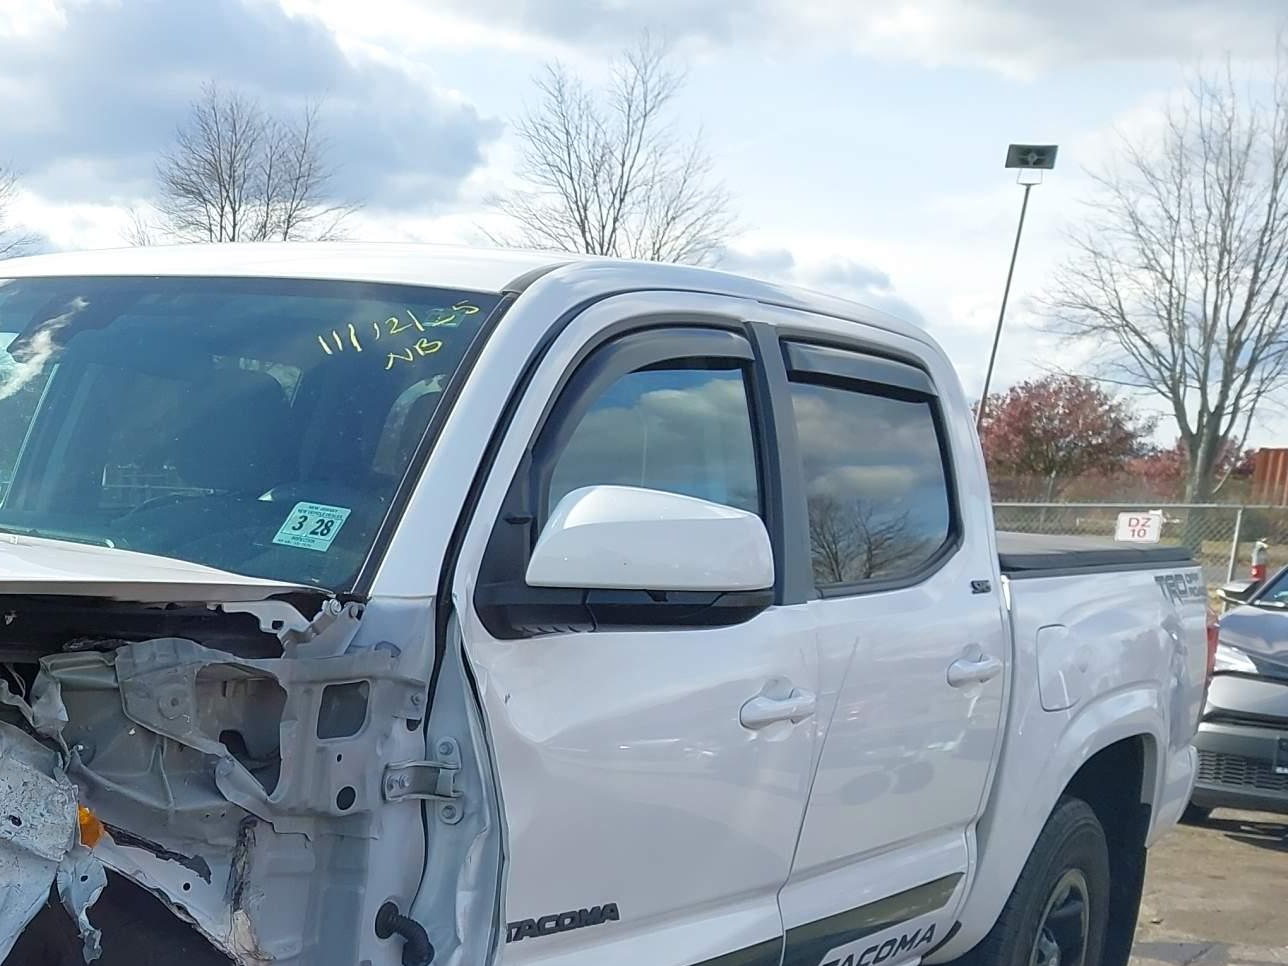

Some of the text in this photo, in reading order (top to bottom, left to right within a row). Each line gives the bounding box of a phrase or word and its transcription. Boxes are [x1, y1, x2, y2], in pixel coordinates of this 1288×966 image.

[384, 338, 443, 370] NB
[292, 515, 335, 537] 3 28
[1128, 517, 1152, 528] DZ
[1131, 528, 1147, 538] 10
[1154, 574, 1187, 606] TRD
[506, 902, 620, 943] TACOMA
